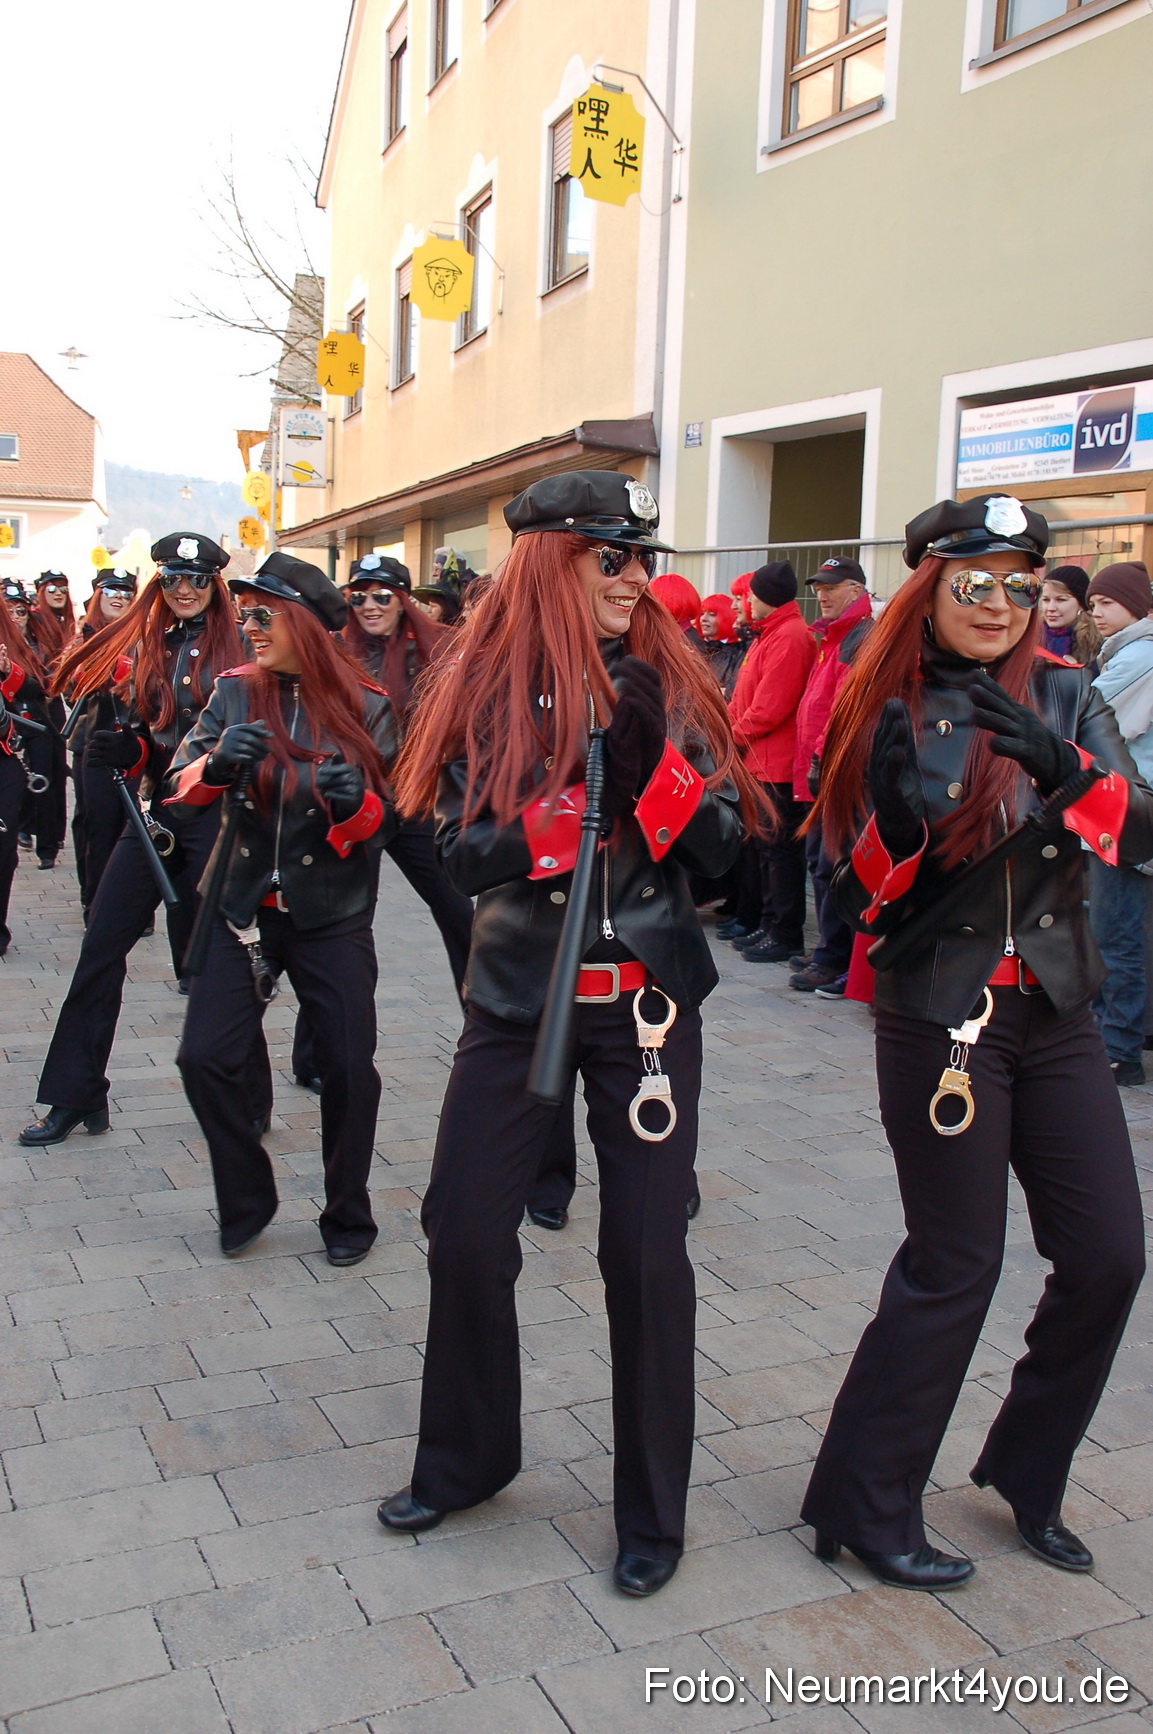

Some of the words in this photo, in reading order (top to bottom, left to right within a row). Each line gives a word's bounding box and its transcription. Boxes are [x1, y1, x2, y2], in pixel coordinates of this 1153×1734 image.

[613, 137, 639, 178] 华
[961, 433, 1070, 458] IMMOBILIENBÜRO
[1080, 412, 1128, 450] ivd
